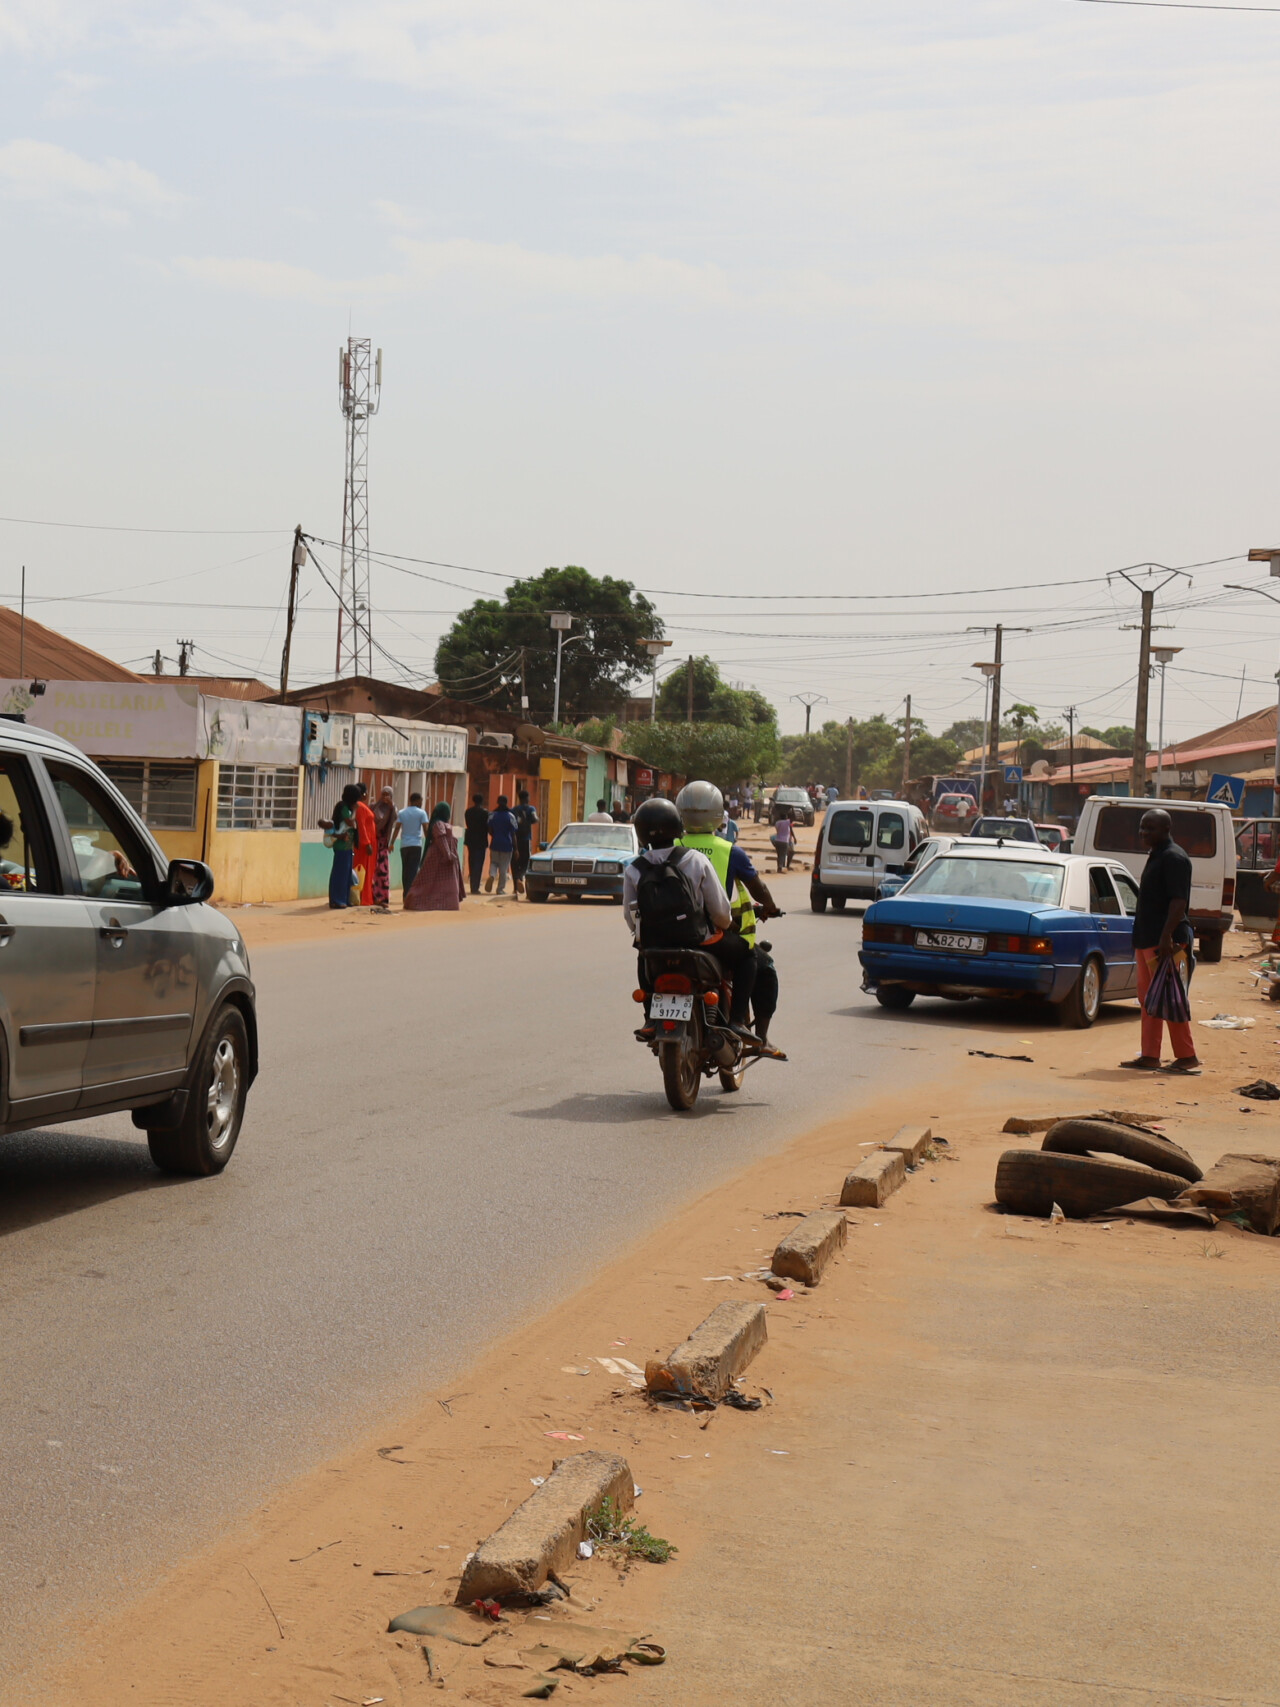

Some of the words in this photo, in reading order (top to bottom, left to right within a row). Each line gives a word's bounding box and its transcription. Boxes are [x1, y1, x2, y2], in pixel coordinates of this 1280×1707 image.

[54, 691, 167, 712] PASTELARIA
[54, 720, 133, 740] QUELELE
[367, 731, 419, 756] FARMACIA
[421, 735, 457, 759] QUELELE
[692, 847, 713, 855] OTO
